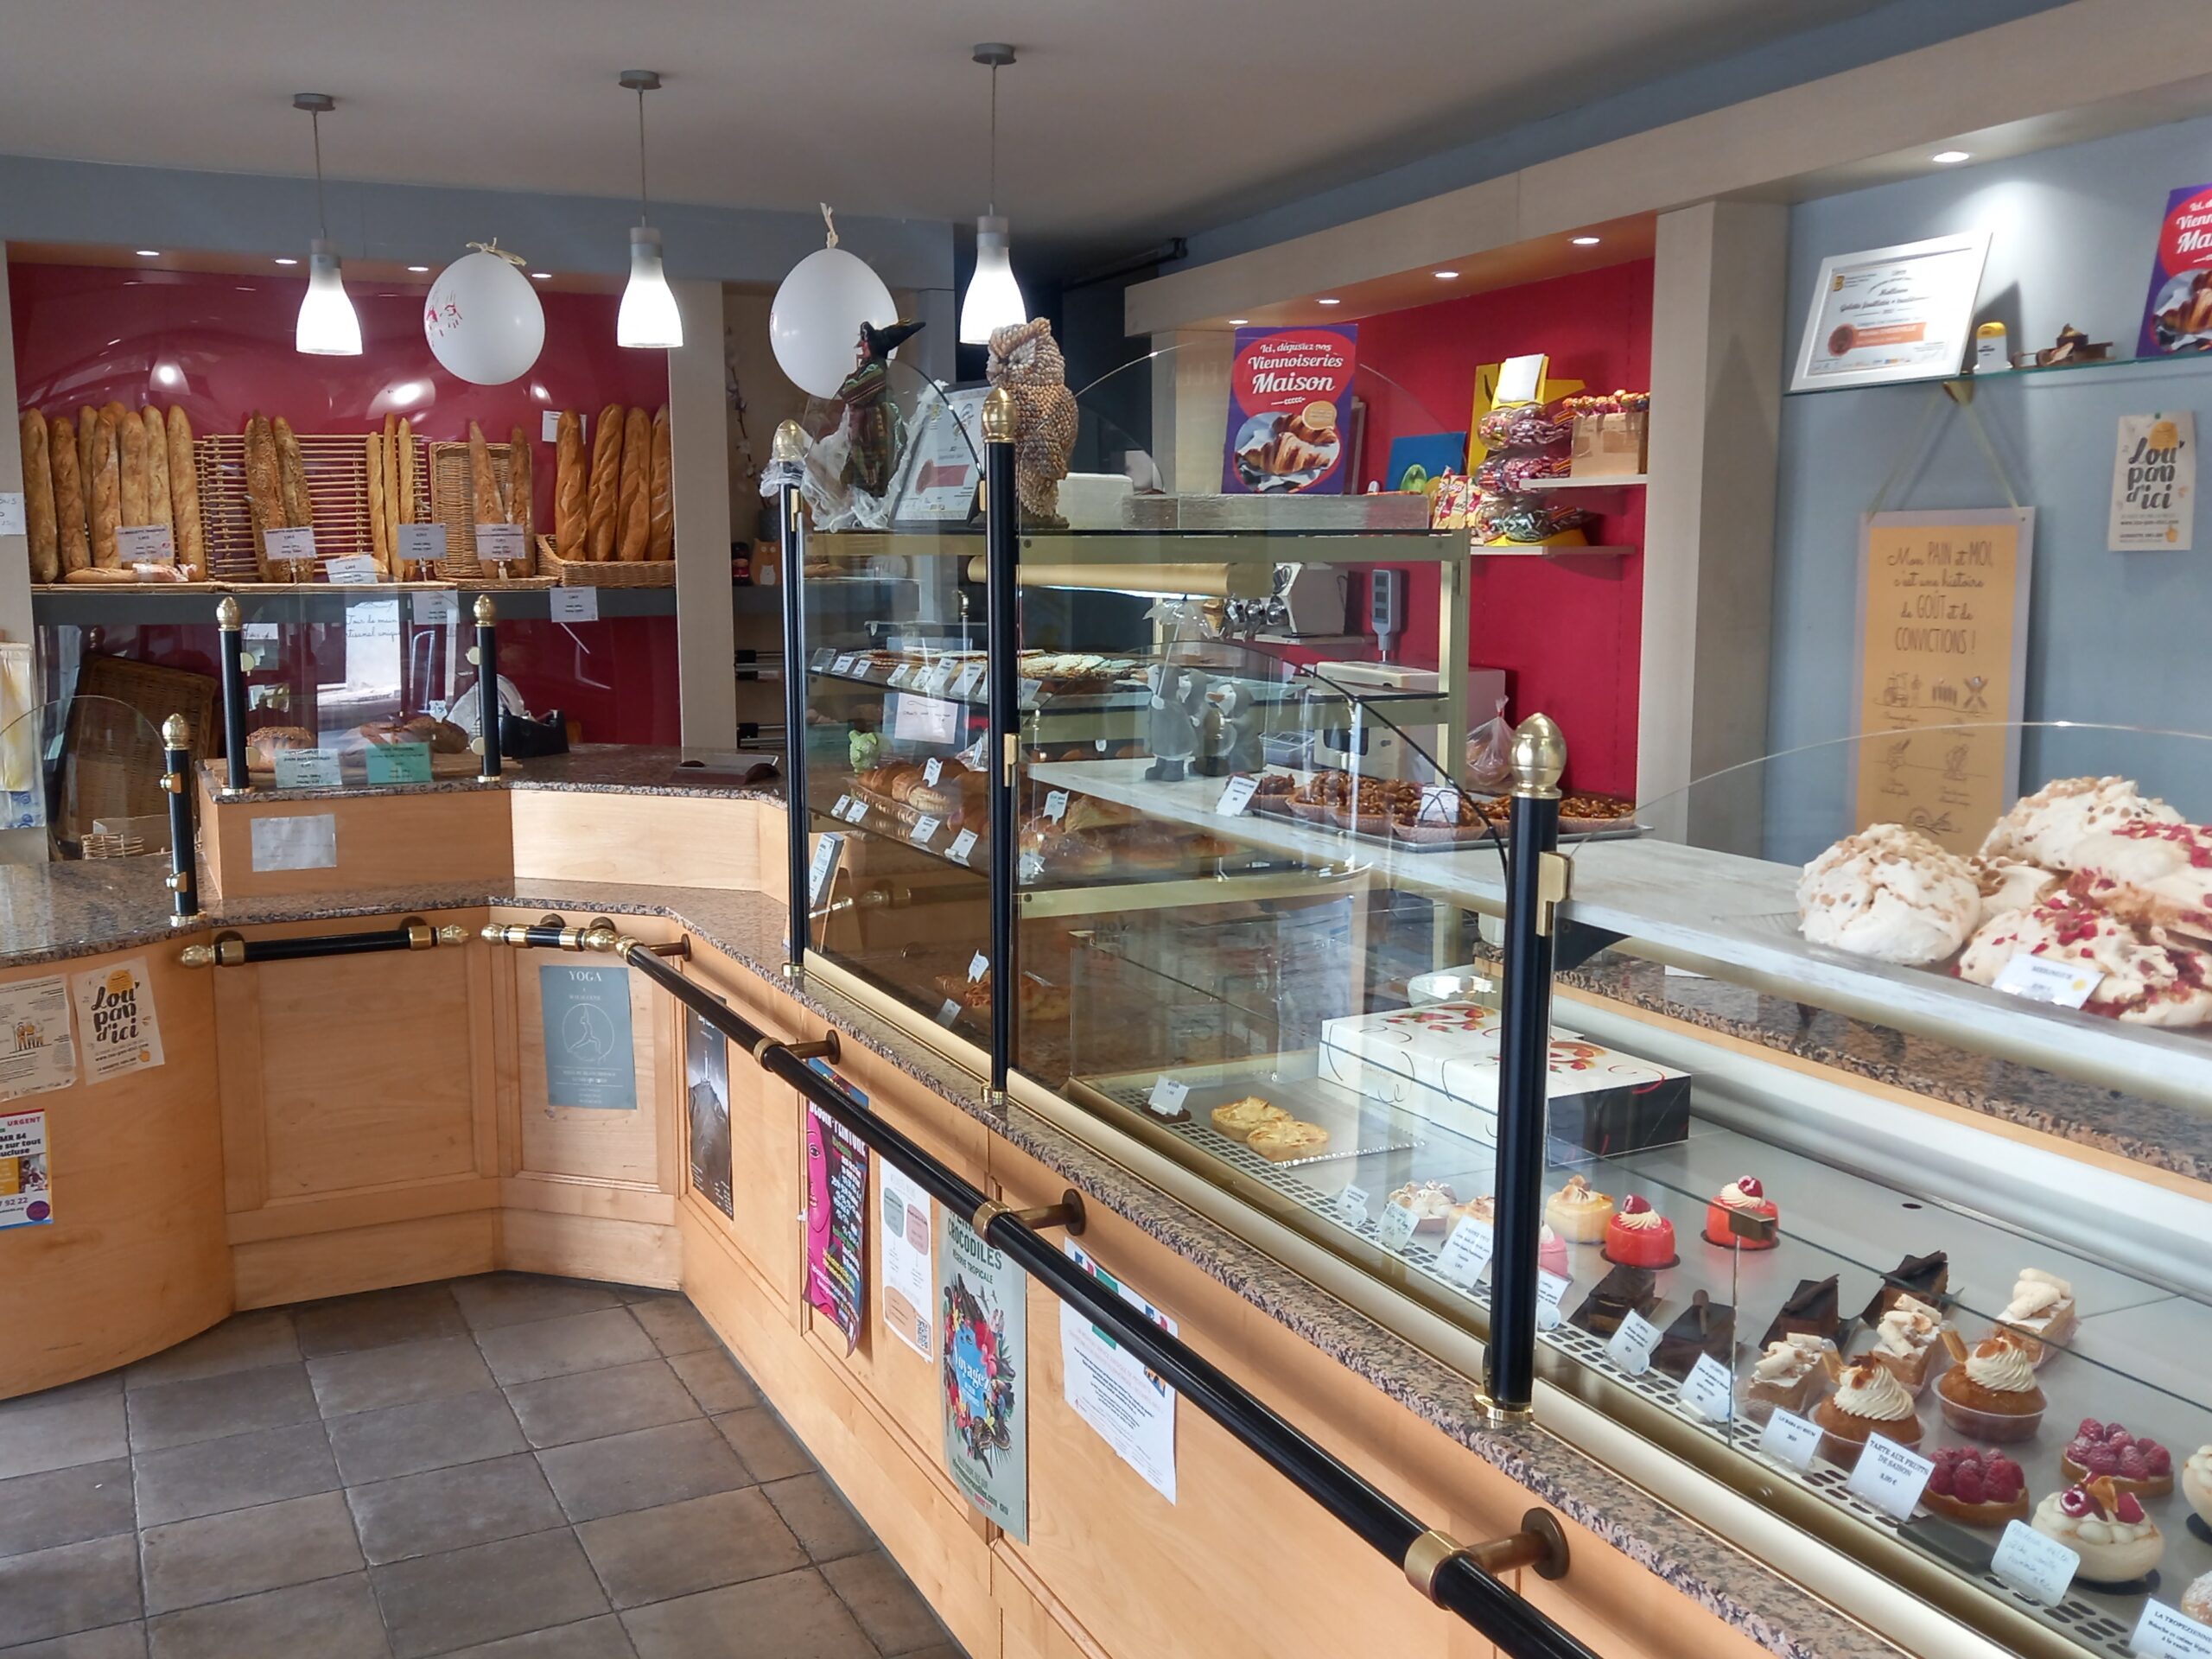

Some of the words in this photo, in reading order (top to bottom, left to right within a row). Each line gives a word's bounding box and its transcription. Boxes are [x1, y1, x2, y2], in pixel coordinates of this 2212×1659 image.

[2176, 214, 2212, 230] Vienn
[2177, 229, 2212, 254] Ma
[1248, 353, 1344, 370] Viennoiseries
[1252, 372, 1336, 394] Maison
[2127, 465, 2176, 491] pan
[2126, 483, 2172, 509] d'ici
[1887, 548, 1924, 566] Mon
[1928, 541, 1952, 566] PAIN
[1942, 568, 1985, 588] histoire
[1901, 601, 1912, 618] de
[1960, 602, 1974, 620] de
[1894, 626, 1967, 654] CONVICTIONS
[569, 969, 602, 982] YOGA
[93, 1002, 137, 1033] pan
[96, 1018, 139, 1044] d'ici
[7, 1116, 41, 1126] URGENT
[0, 1147, 30, 1157] ucluse
[5, 1141, 20, 1150] sur
[22, 1138, 41, 1147] tout
[948, 1217, 1002, 1270] CROCODILES
[1870, 1440, 1891, 1455] TARTE
[1891, 1452, 1905, 1463] AUX
[1904, 1459, 1929, 1476] FRUITS
[1878, 1454, 1888, 1465] DE
[1887, 1459, 1913, 1477] SAISON
